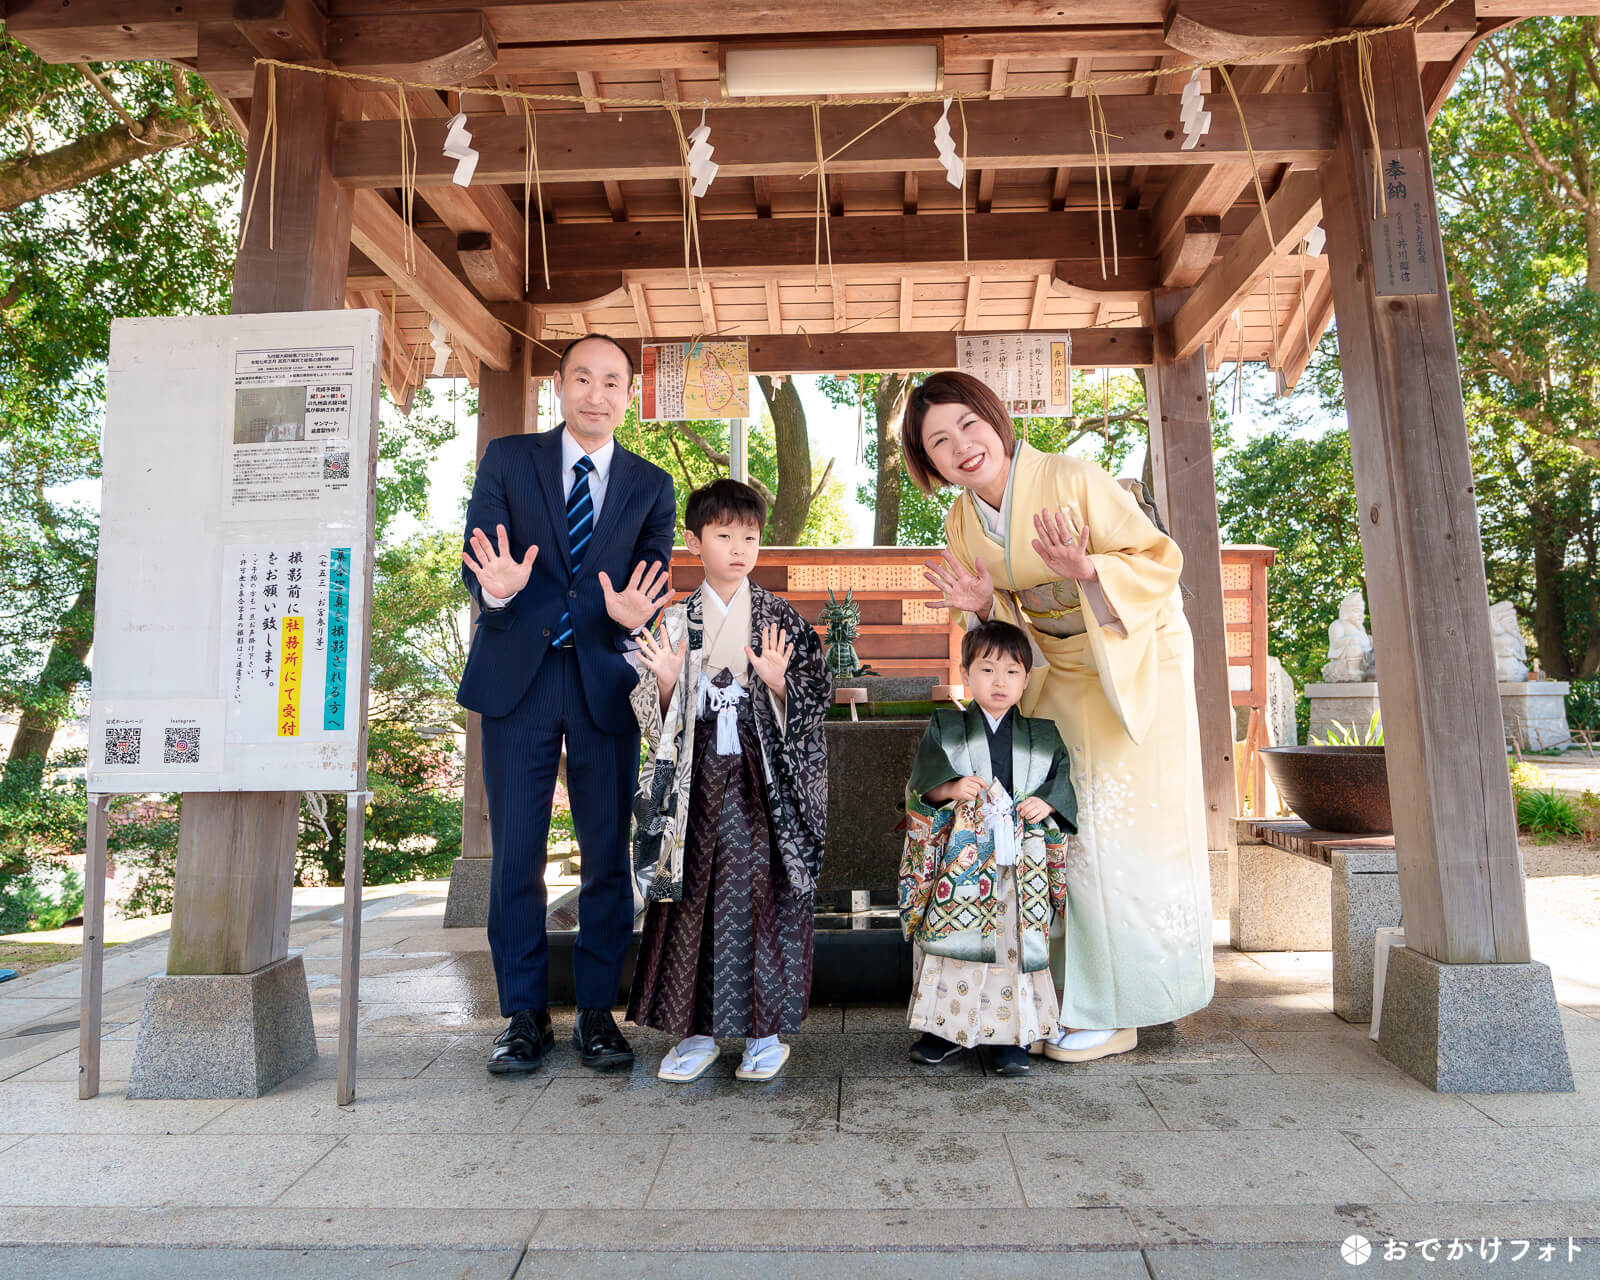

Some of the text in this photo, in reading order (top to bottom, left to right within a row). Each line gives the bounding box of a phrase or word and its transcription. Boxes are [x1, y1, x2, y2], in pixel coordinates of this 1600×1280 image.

[1385, 159, 1407, 200] 奉納
[261, 551, 279, 687] をお願い致します。
[281, 551, 304, 736] 撮影前に社務所にて受付
[327, 550, 347, 727] 集合写真を撮影される方へ
